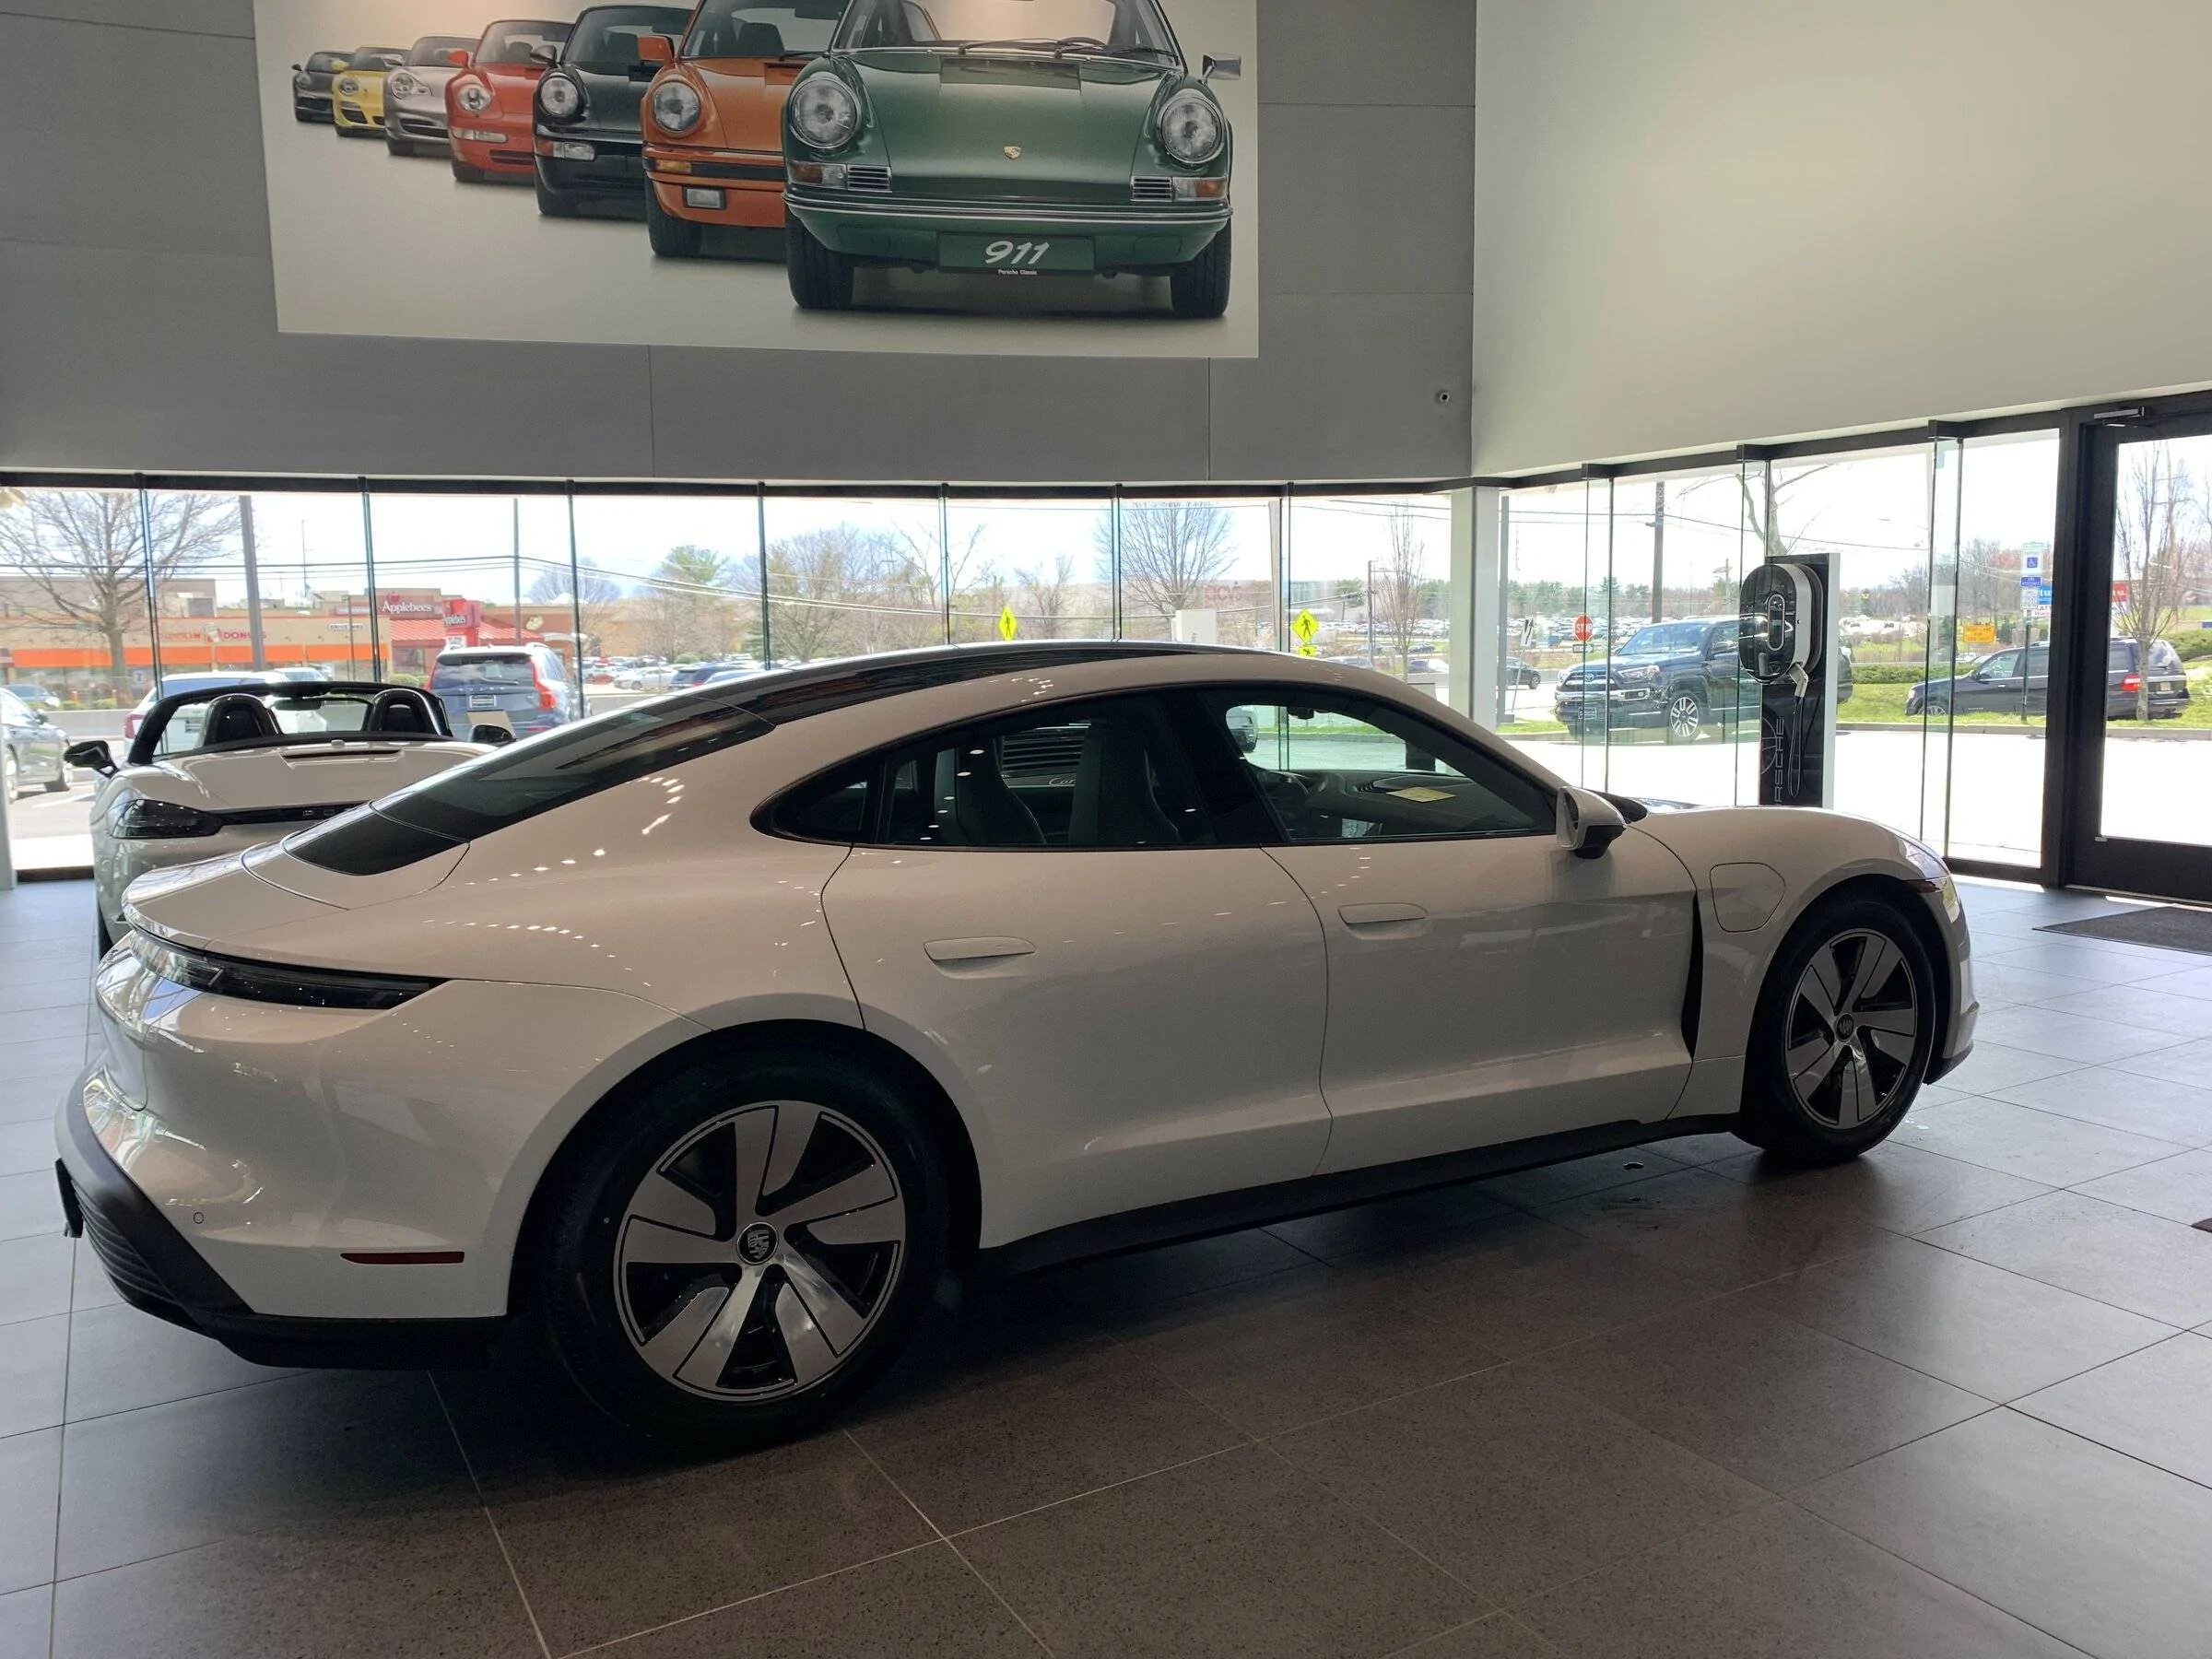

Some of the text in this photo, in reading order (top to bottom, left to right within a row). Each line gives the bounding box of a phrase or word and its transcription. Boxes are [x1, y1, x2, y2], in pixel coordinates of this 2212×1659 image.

[985, 241, 1049, 264] 911
[221, 631, 267, 641] DONS
[1774, 719, 1784, 803] RSCHE
